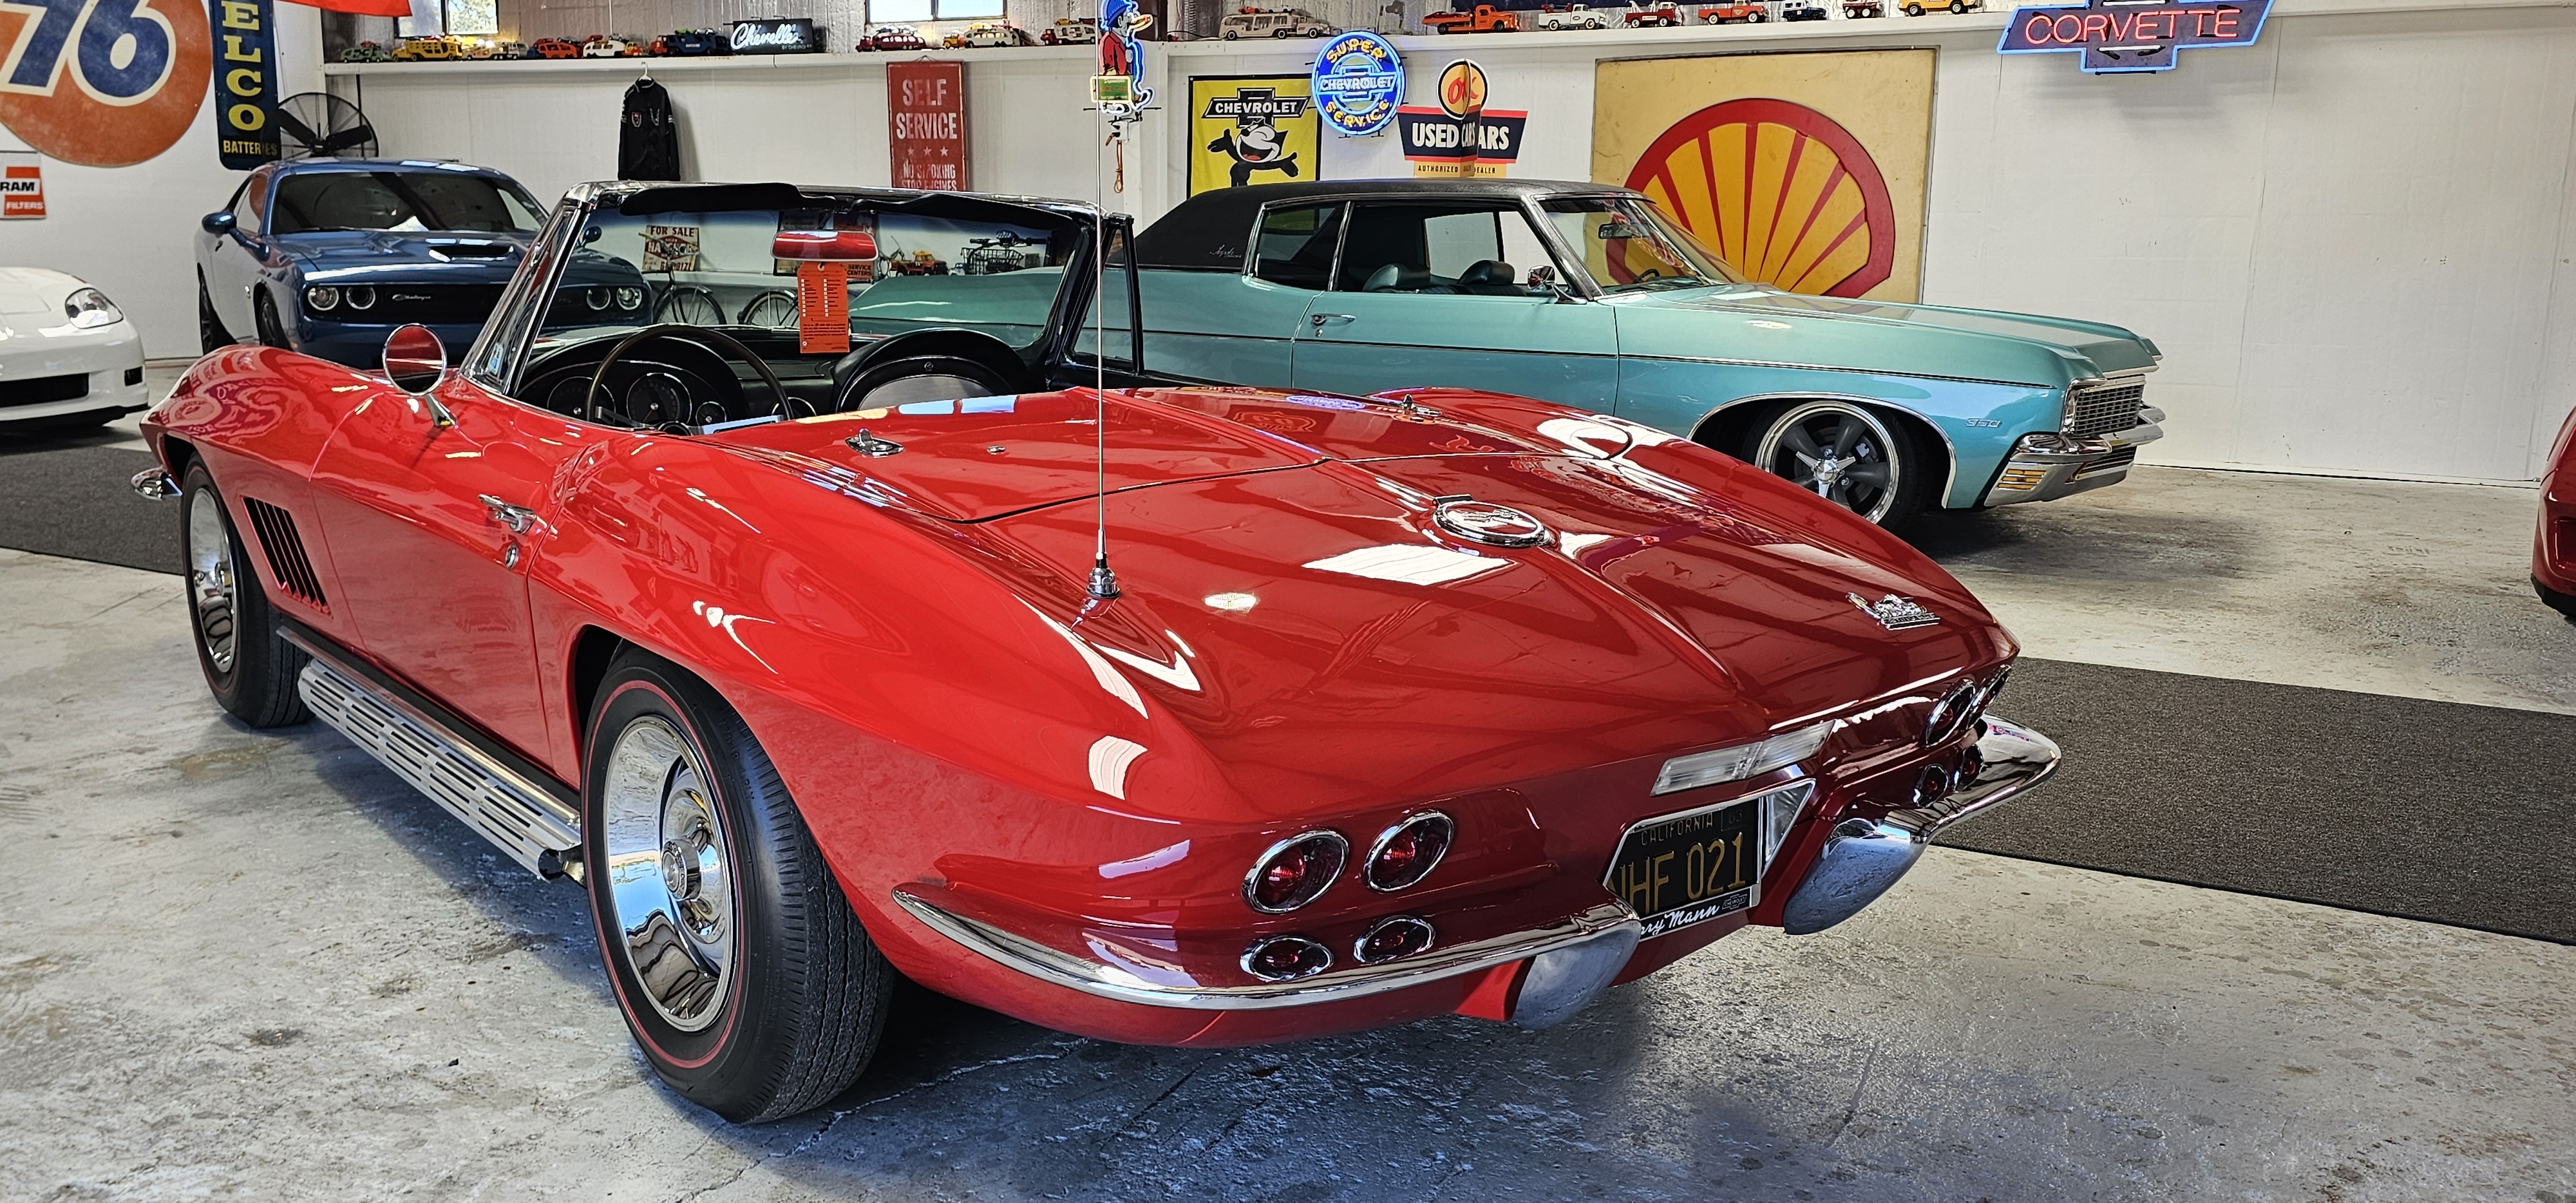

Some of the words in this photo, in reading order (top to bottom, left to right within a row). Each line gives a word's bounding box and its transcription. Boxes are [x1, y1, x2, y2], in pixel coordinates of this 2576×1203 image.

[730, 23, 800, 50] Chevelle
[2025, 8, 2242, 44] CORVETTE
[0, 0, 175, 106] 76
[1326, 38, 1387, 63] SUPER
[902, 79, 947, 106] SELF
[1321, 76, 1394, 91] CHEVROLET
[1215, 102, 1297, 114] CHEVROLET
[1325, 99, 1392, 128] SERVICE
[896, 112, 958, 140] SERVICE
[1412, 122, 1459, 148] USED
[1478, 126, 1510, 150] ARS
[223, 140, 278, 156] BATTERIES
[903, 160, 914, 179] NO
[0, 182, 35, 192] RAM
[650, 226, 668, 235] FOR
[672, 227, 694, 237] SALE
[1964, 417, 2002, 428] 350
[1642, 812, 1713, 846] CALIFORNIA
[1686, 830, 1746, 900] 021
[1663, 904, 1721, 929] Mann
